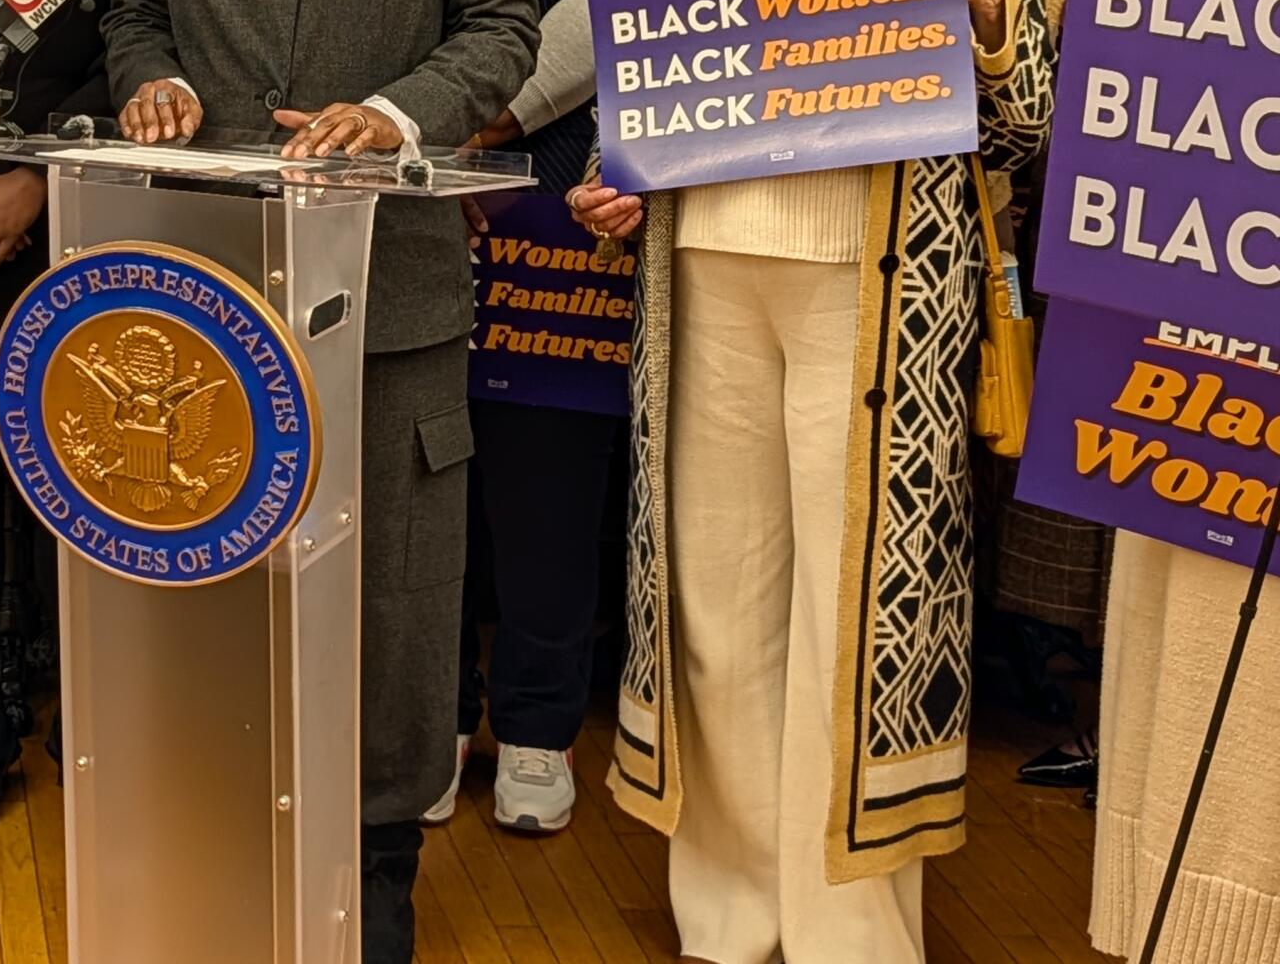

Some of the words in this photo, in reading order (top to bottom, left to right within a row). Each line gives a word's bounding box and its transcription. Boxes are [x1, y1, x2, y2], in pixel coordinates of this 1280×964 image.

[616, 44, 752, 93] BLACK
[759, 20, 956, 71] Families.
[619, 94, 755, 141] BLACK
[761, 73, 952, 121] Futures.
[1069, 175, 1280, 285] BLAC
[4, 301, 55, 396] HOUSE
[50, 276, 83, 310] OF
[83, 264, 300, 432] REPRESENTATIVES
[5, 407, 69, 521] UNITED
[70, 514, 169, 573] STATES
[177, 543, 212, 573] OF
[220, 447, 300, 563] AMERICA
